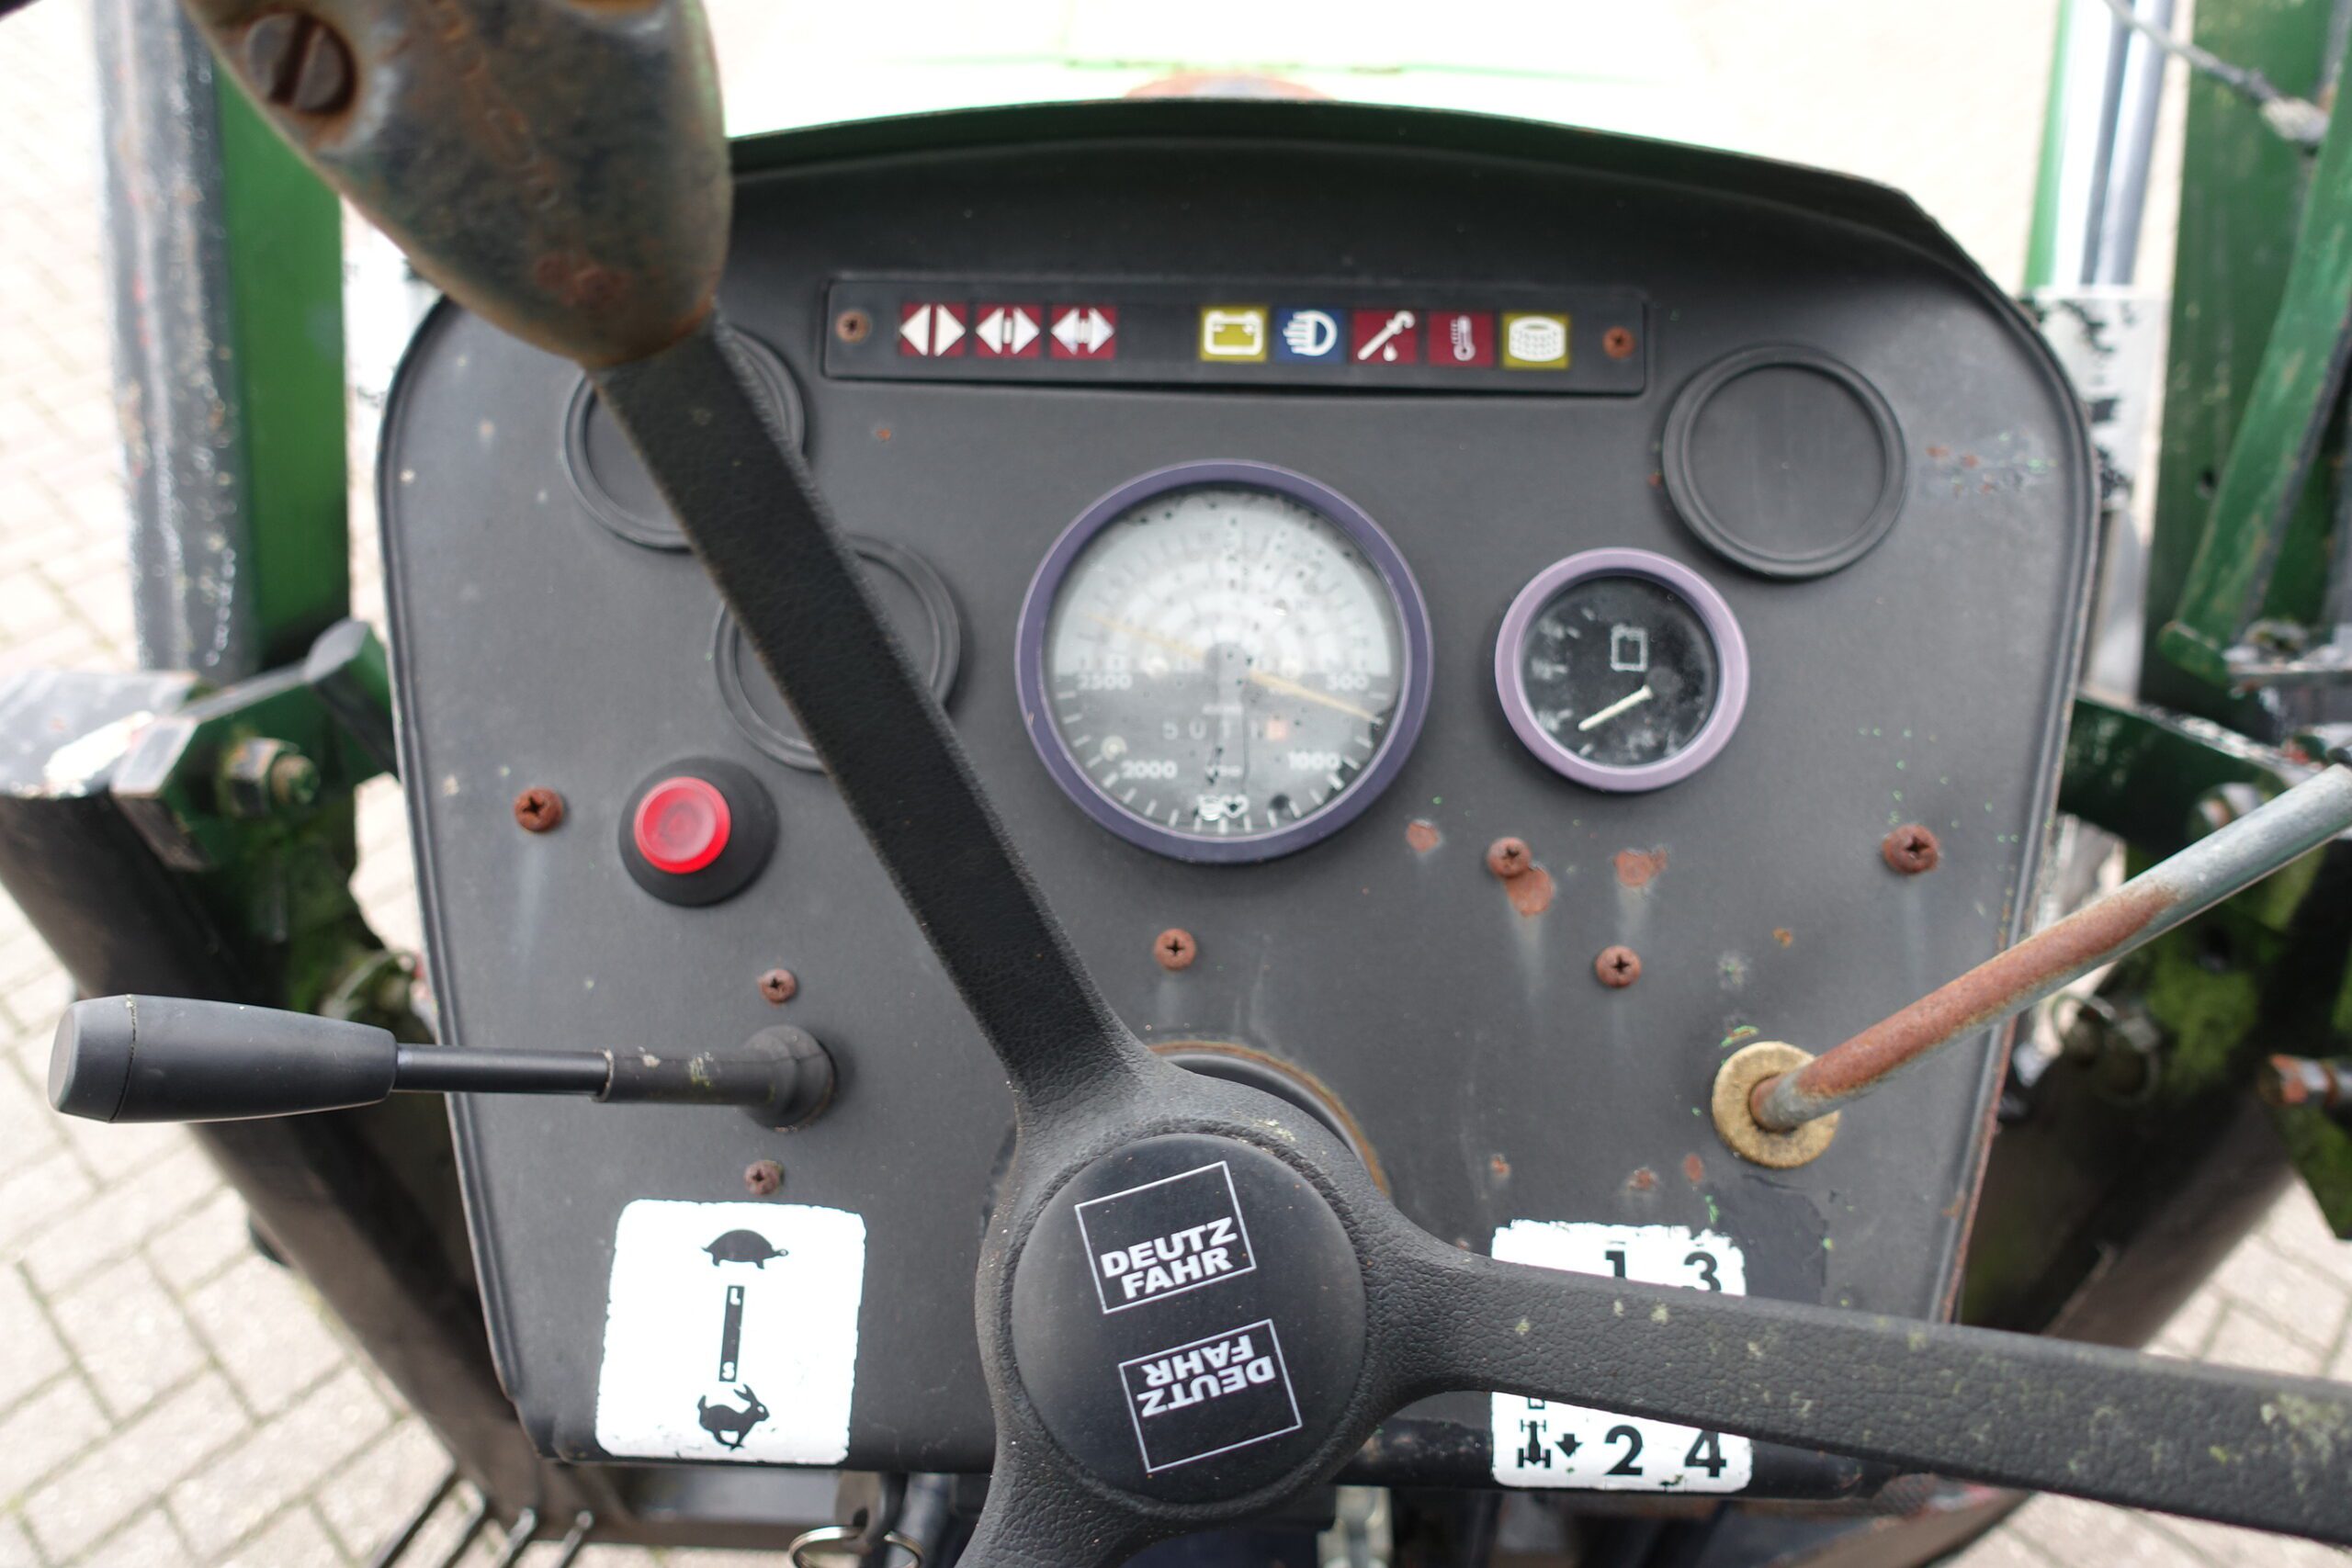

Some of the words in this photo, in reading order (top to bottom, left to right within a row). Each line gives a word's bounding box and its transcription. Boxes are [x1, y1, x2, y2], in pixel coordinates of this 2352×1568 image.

[1326, 673, 1370, 690] 500
[1120, 759, 1178, 779] 2000
[1287, 750, 1341, 770] 1000
[1100, 1216, 1238, 1279] DEUTZ
[1120, 1247, 1233, 1300] FAHR
[1683, 1250, 1722, 1292] 3
[729, 1288, 741, 1305] L
[721, 1361, 735, 1380] S
[1140, 1335, 1255, 1388] FAHR
[1136, 1355, 1275, 1417] DEUTZ
[1604, 1424, 1644, 1476] 2
[1684, 1429, 1727, 1478] 4
